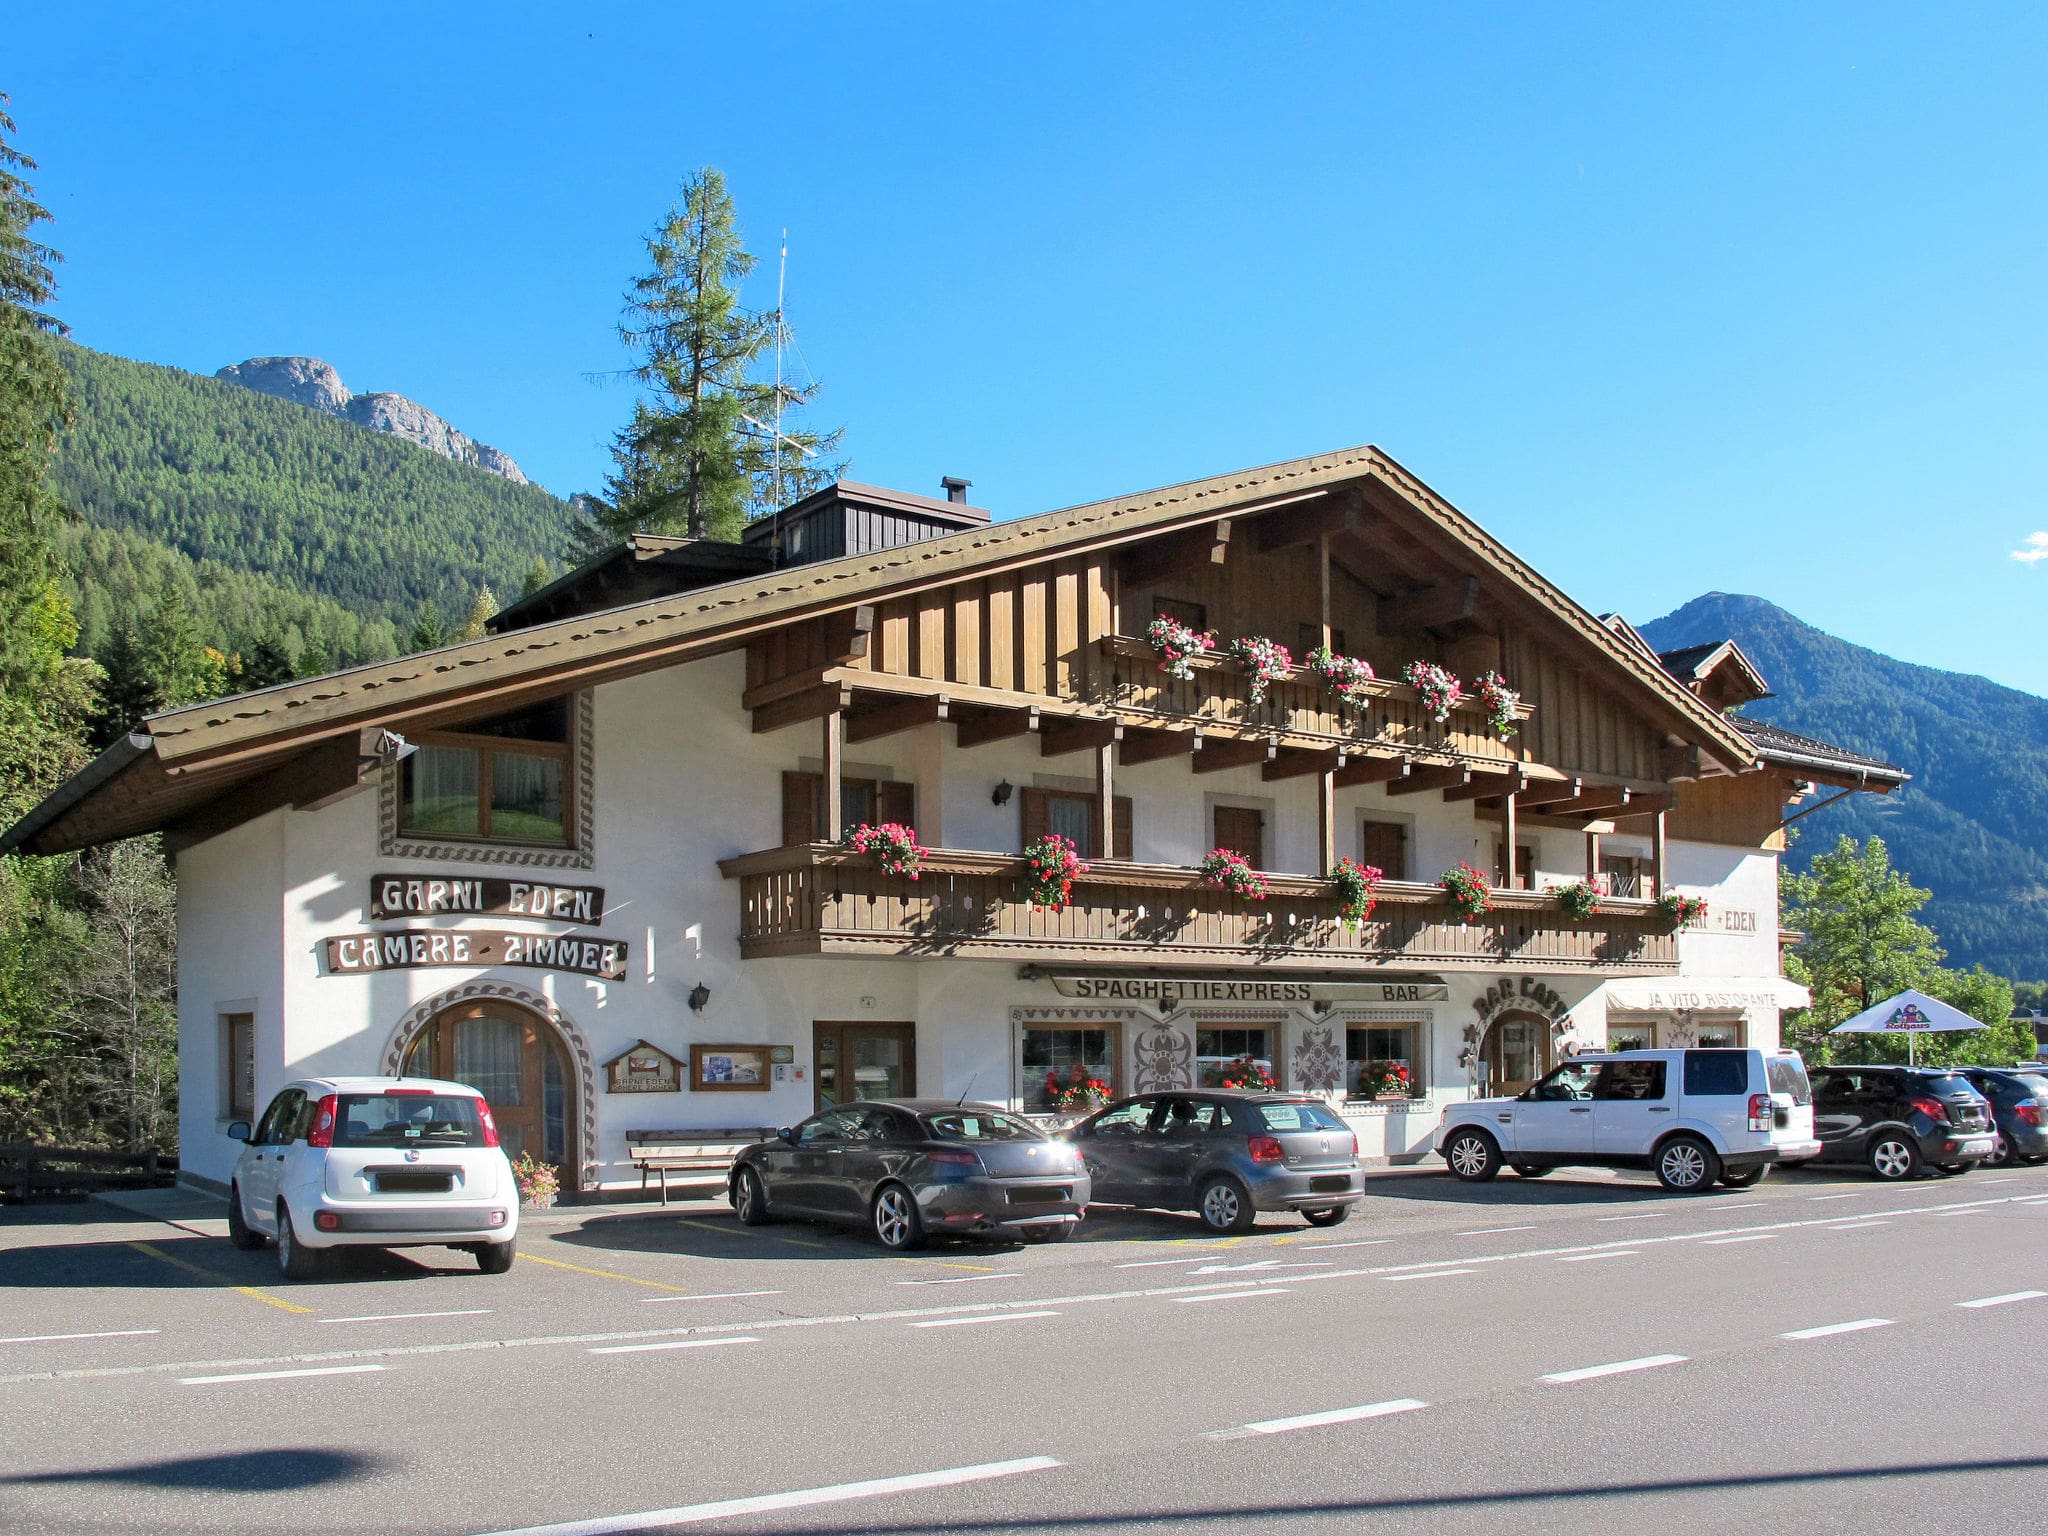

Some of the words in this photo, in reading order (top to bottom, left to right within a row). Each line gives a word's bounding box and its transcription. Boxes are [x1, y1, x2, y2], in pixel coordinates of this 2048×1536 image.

[382, 880, 483, 911] GARNI
[508, 883, 594, 920] EDEN
[1725, 910, 1756, 932] EDEN
[338, 934, 472, 968] CAMERE
[504, 935, 619, 972] ZIMMER
[1076, 979, 1311, 1000] SPAGHETTIEXPRESS
[1383, 984, 1419, 1000] BAR
[1473, 978, 1516, 1020] BAR
[1669, 992, 1700, 1007] VITO
[1705, 992, 1777, 1007] RISTORANTE
